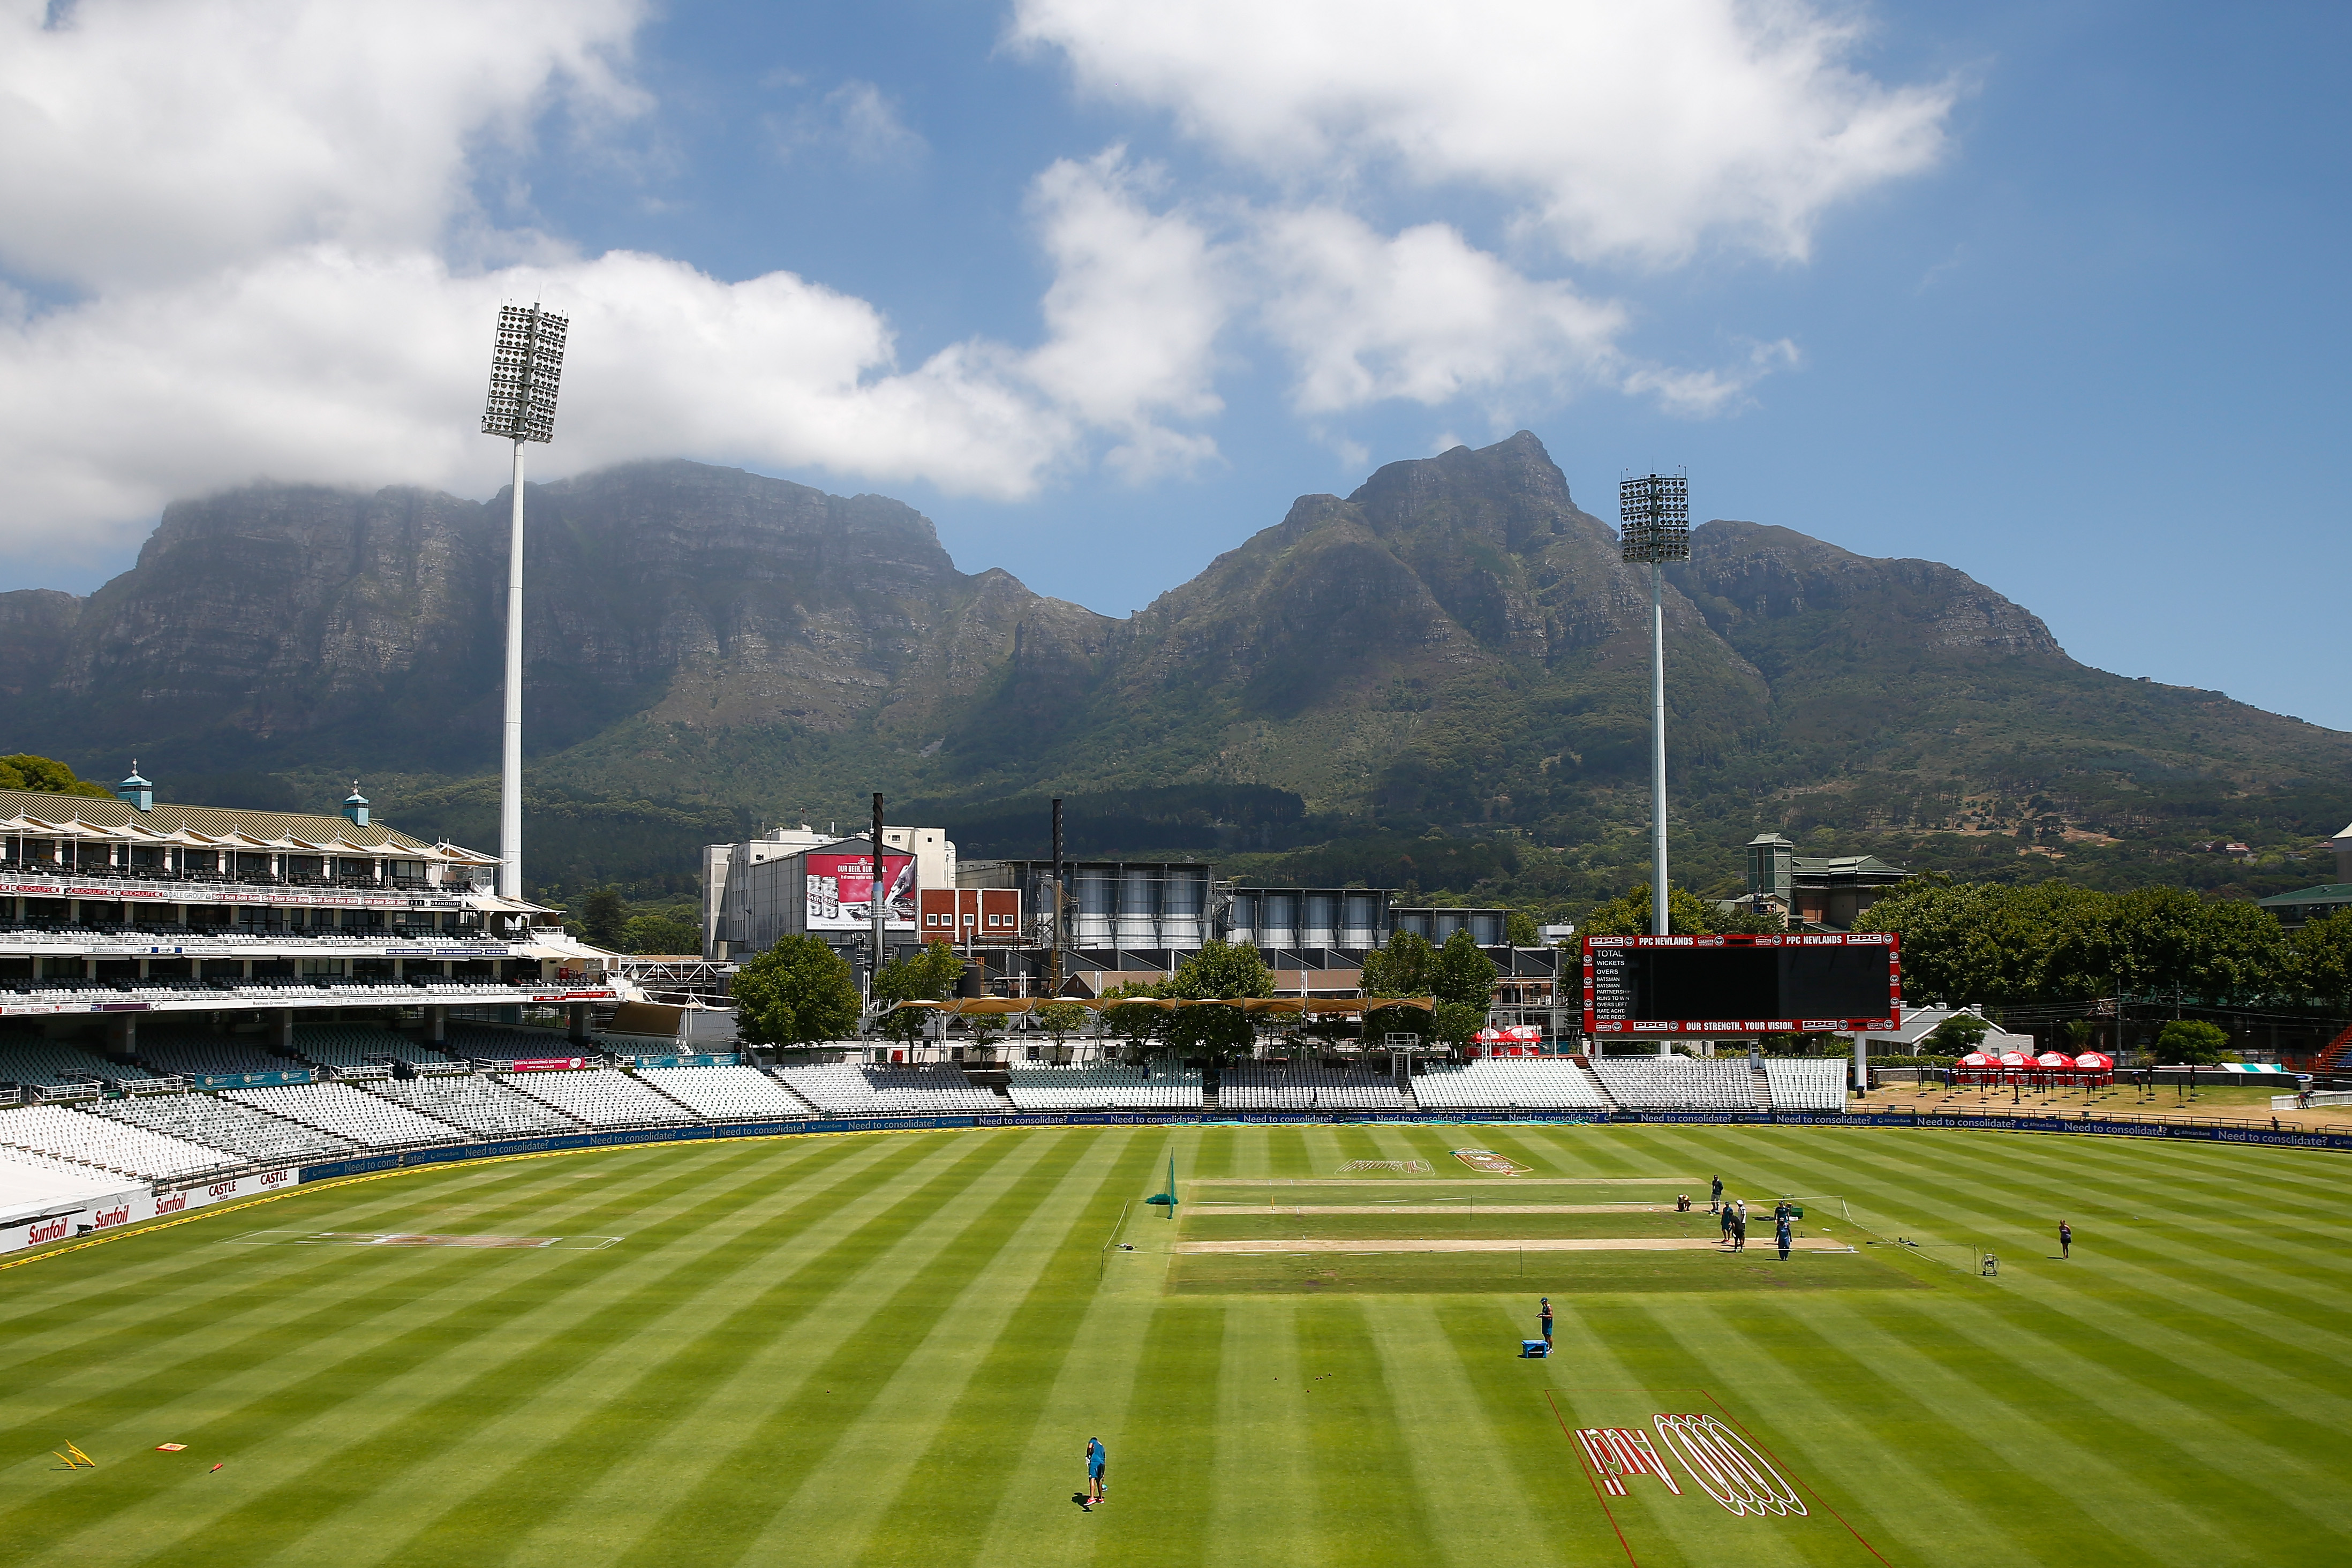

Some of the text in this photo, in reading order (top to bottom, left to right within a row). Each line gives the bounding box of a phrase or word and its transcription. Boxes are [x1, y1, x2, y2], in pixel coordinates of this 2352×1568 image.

[1655, 937, 1693, 945] NEWLANDS
[1786, 936, 1842, 944] PPC NEWLANDS
[1686, 1021, 1795, 1031] OUR STRENGTH, YOUR VISION.
[2003, 1055, 2020, 1063] CASTLE
[979, 1117, 1001, 1125] Need
[1015, 1115, 1068, 1125] consolidate?
[1111, 1115, 1133, 1123] Need
[1147, 1114, 1202, 1124] consolidate?
[1243, 1114, 1267, 1122] Need
[1280, 1114, 1333, 1122] consolidate?
[1413, 1114, 1466, 1122] consolidate?
[1546, 1113, 1599, 1122] consolidate?
[1641, 1114, 1664, 1122] Need
[1678, 1114, 1732, 1122] consolidate?
[1777, 1114, 1800, 1123] Need
[1815, 1115, 1871, 1124] consolidate?
[848, 1121, 871, 1129] Need
[884, 1119, 936, 1128] consolidate?
[1917, 1118, 1942, 1126] Need
[1957, 1119, 2016, 1128] consolidate?
[720, 1127, 741, 1136] Need
[755, 1123, 806, 1134] consolidate?
[2064, 1122, 2168, 1136] Need to consolidate?
[590, 1130, 676, 1145] Need to consolidate?
[2218, 1130, 2328, 1146] Need to consolidate?
[465, 1140, 549, 1157] Need to consolidate?
[344, 1162, 365, 1173] Need
[367, 1161, 375, 1169] to
[260, 1171, 288, 1185] CASTLE
[208, 1181, 236, 1197] CASTLE
[155, 1192, 186, 1215] Sunfoil
[95, 1204, 130, 1228] Sunfoil
[28, 1217, 68, 1245] Sunfoil
